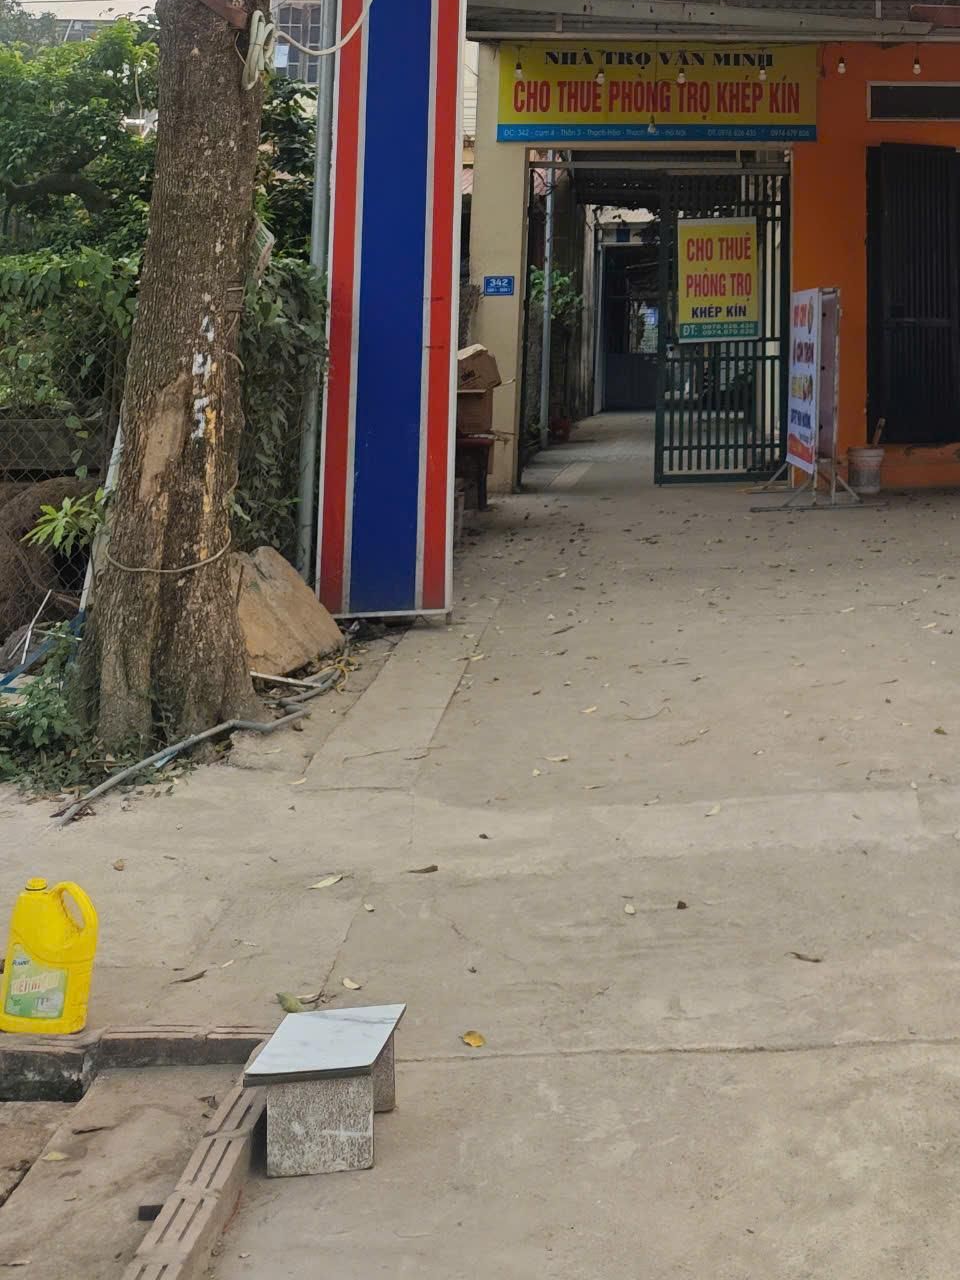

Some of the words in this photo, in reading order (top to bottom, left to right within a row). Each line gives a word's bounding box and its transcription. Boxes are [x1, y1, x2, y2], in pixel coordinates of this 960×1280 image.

[544, 47, 594, 65] NHÀ
[604, 51, 651, 70] TRỌ
[712, 53, 774, 67] MINH
[513, 80, 551, 113] CHO
[608, 73, 671, 113] PHÒNG
[676, 81, 711, 121] TRỌ
[716, 74, 765, 113] KHÉP
[769, 75, 800, 113] KÍN
[686, 237, 713, 262] CHO
[718, 231, 752, 261] THUÊ
[489, 278, 508, 287] 342
[686, 267, 726, 298] PHÒNG
[730, 273, 752, 302] TRỌ
[692, 303, 722, 319] KHÉP
[726, 302, 747, 318] KÍN
